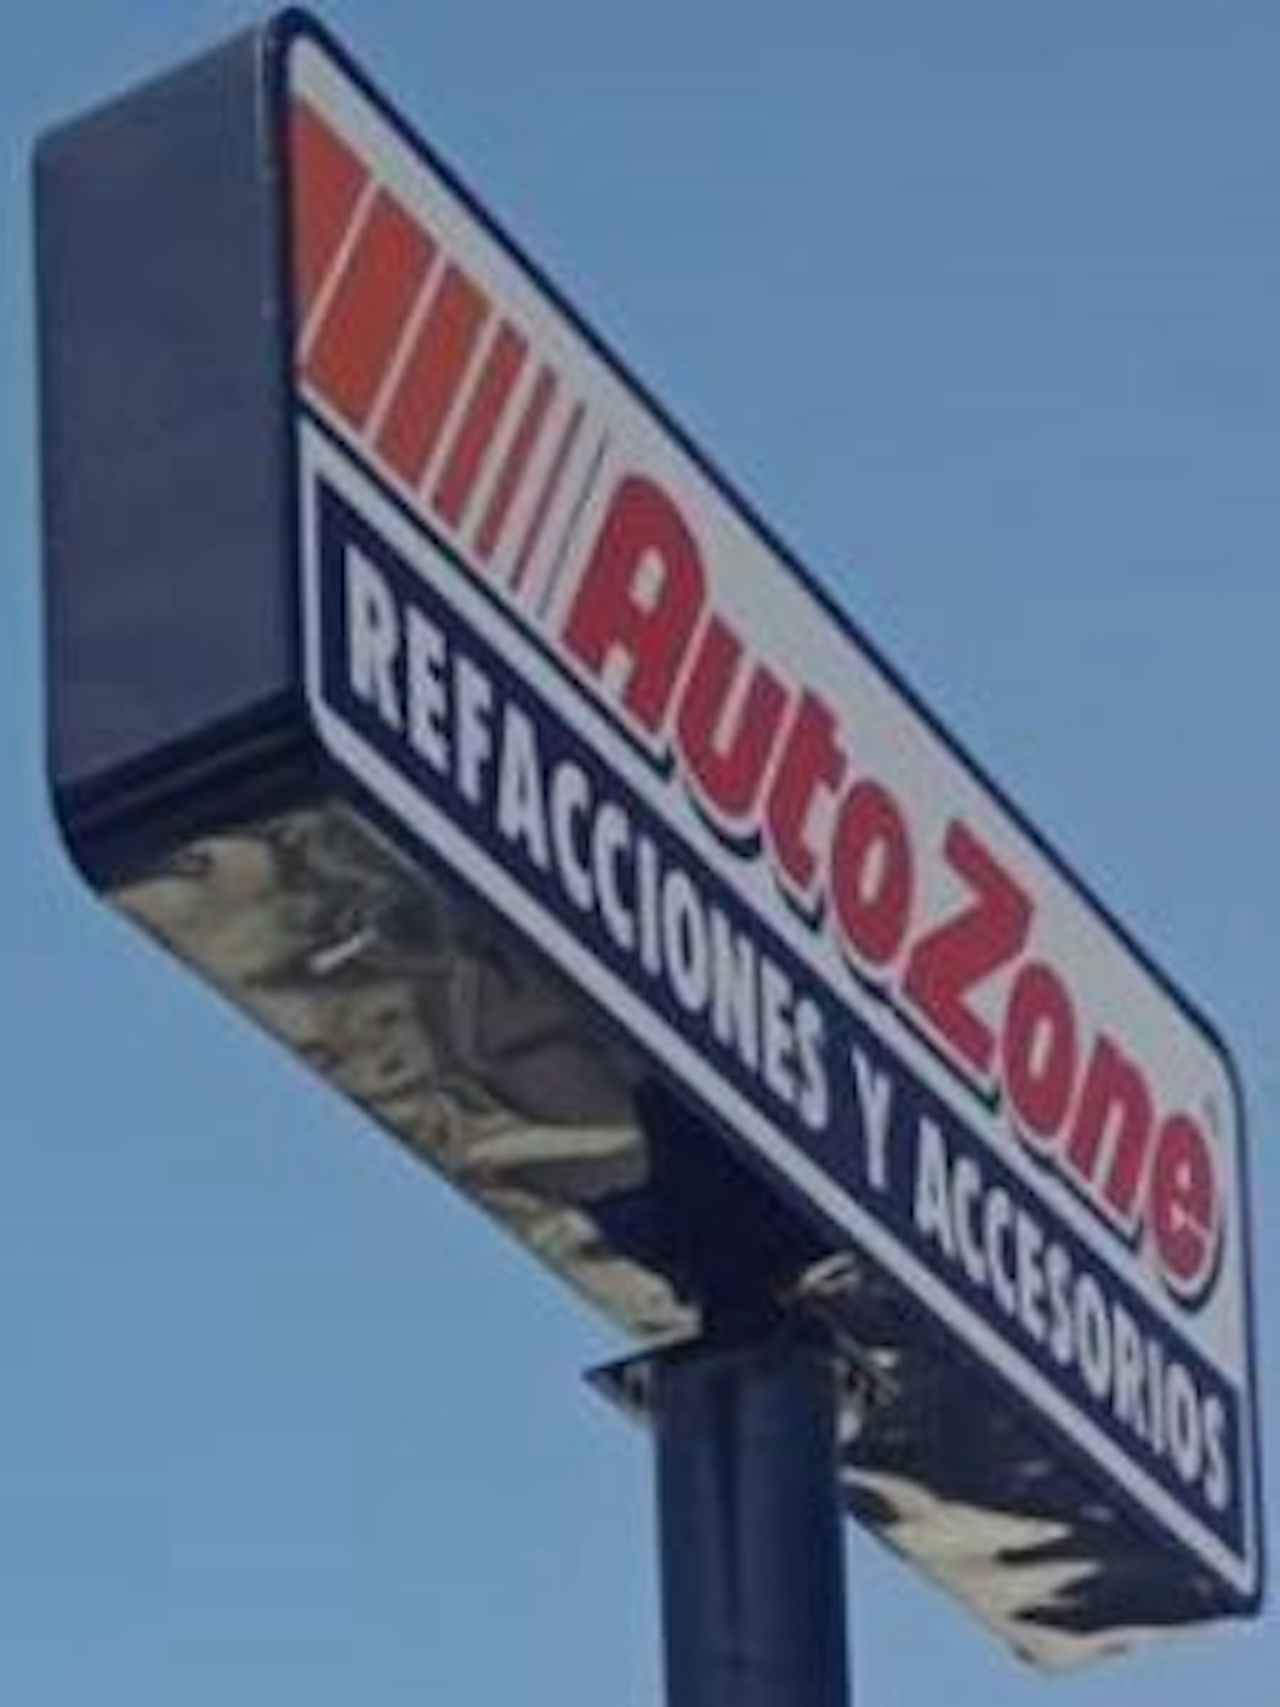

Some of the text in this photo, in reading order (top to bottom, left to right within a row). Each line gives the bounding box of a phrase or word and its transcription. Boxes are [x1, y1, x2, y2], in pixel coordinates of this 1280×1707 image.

[345, 550, 1232, 1506] REFACCIONES Y ACCESORIOS
[562, 473, 1224, 1290] AutoZone
